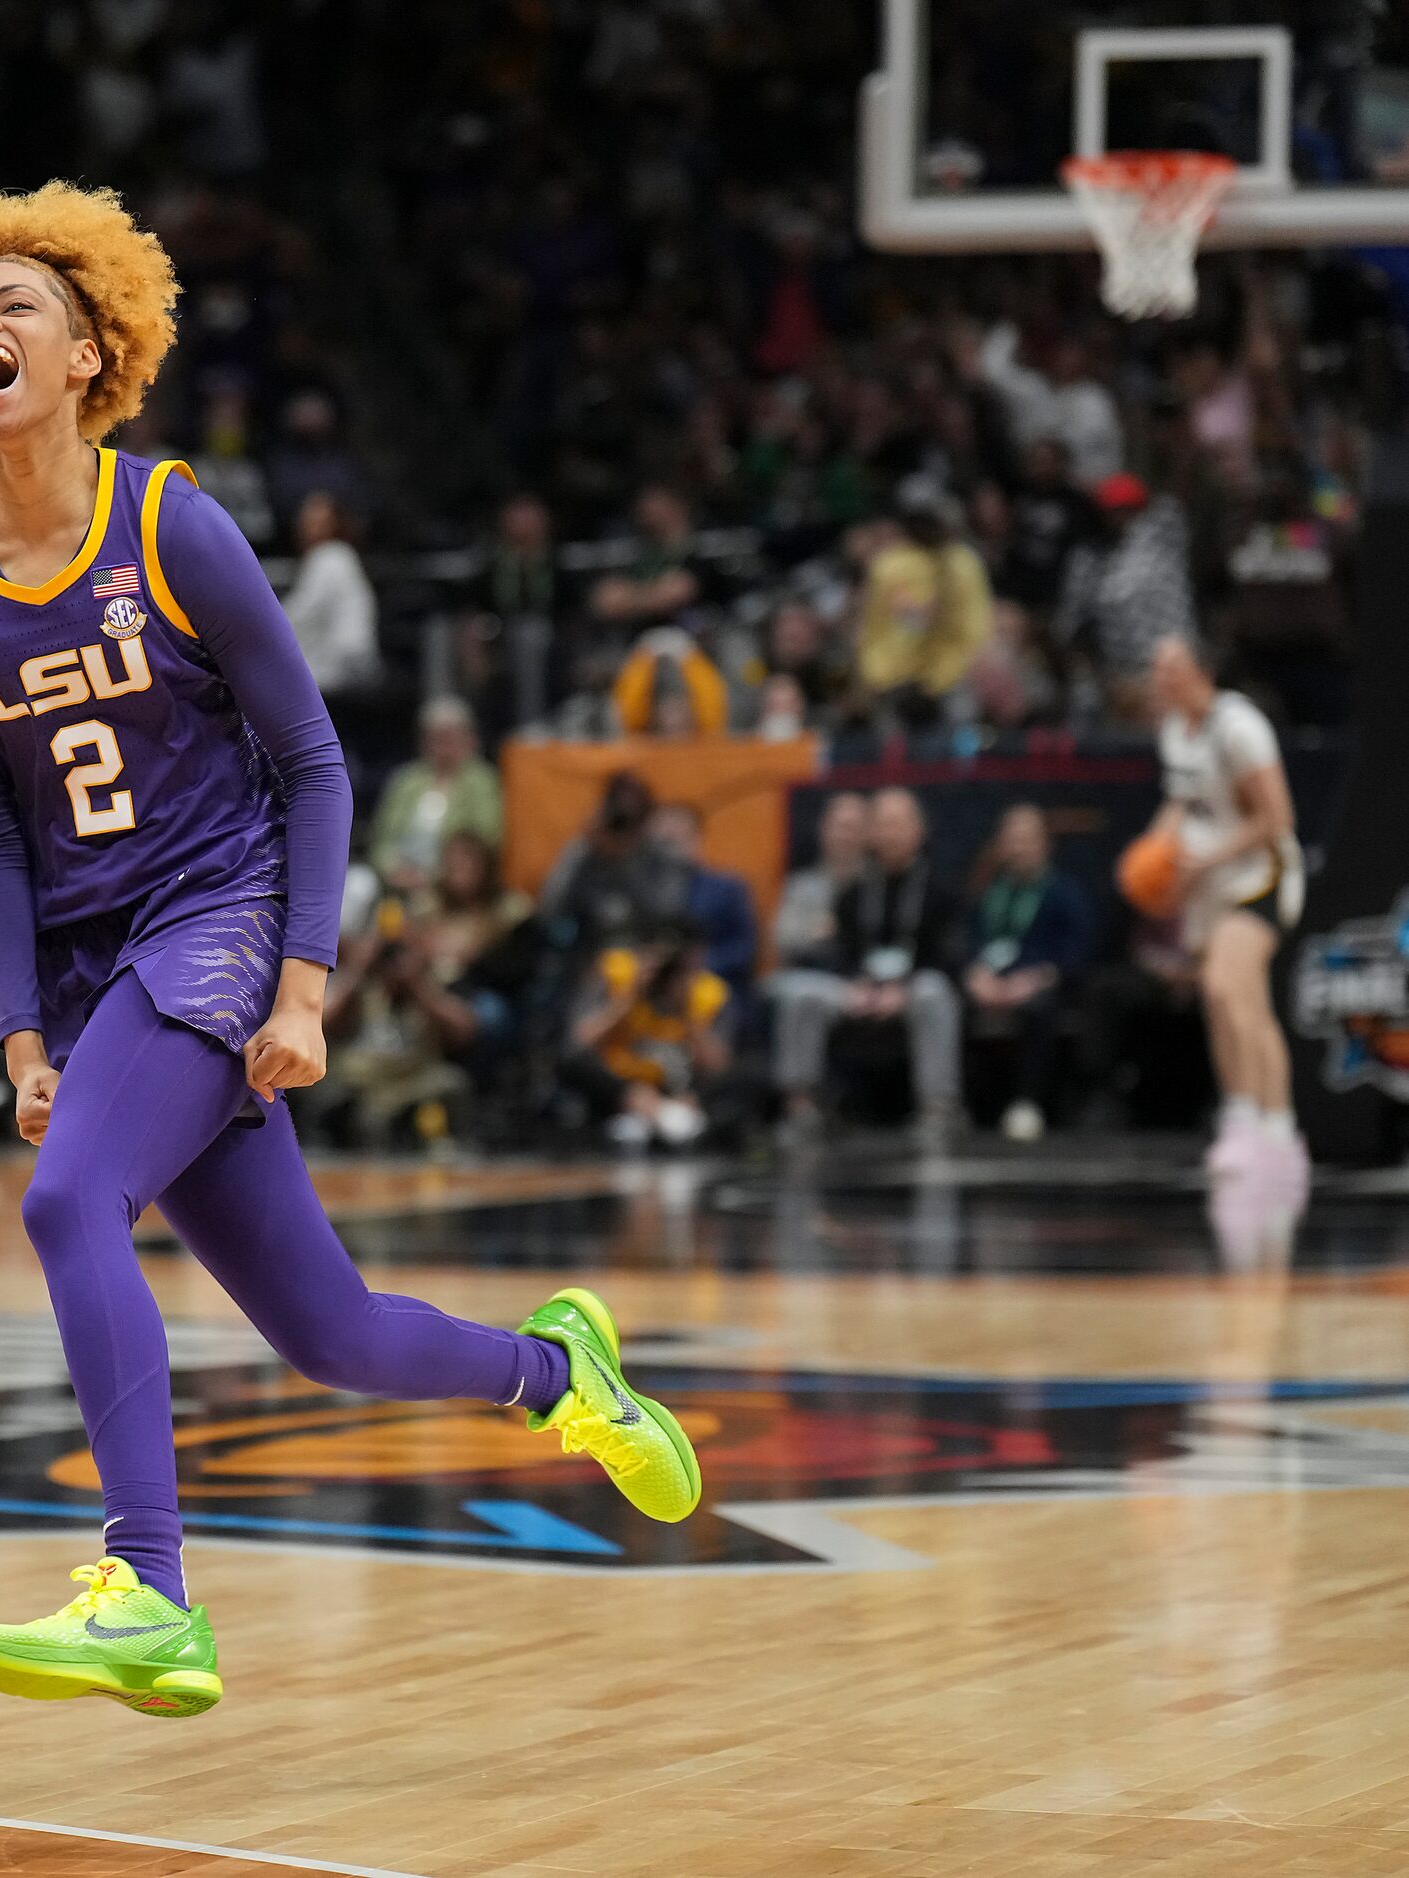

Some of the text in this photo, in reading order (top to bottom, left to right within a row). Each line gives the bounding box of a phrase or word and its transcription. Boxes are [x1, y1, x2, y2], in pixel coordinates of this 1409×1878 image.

[107, 599, 136, 628] SEC
[107, 622, 142, 638] GRADUATE
[49, 719, 136, 837] 2
